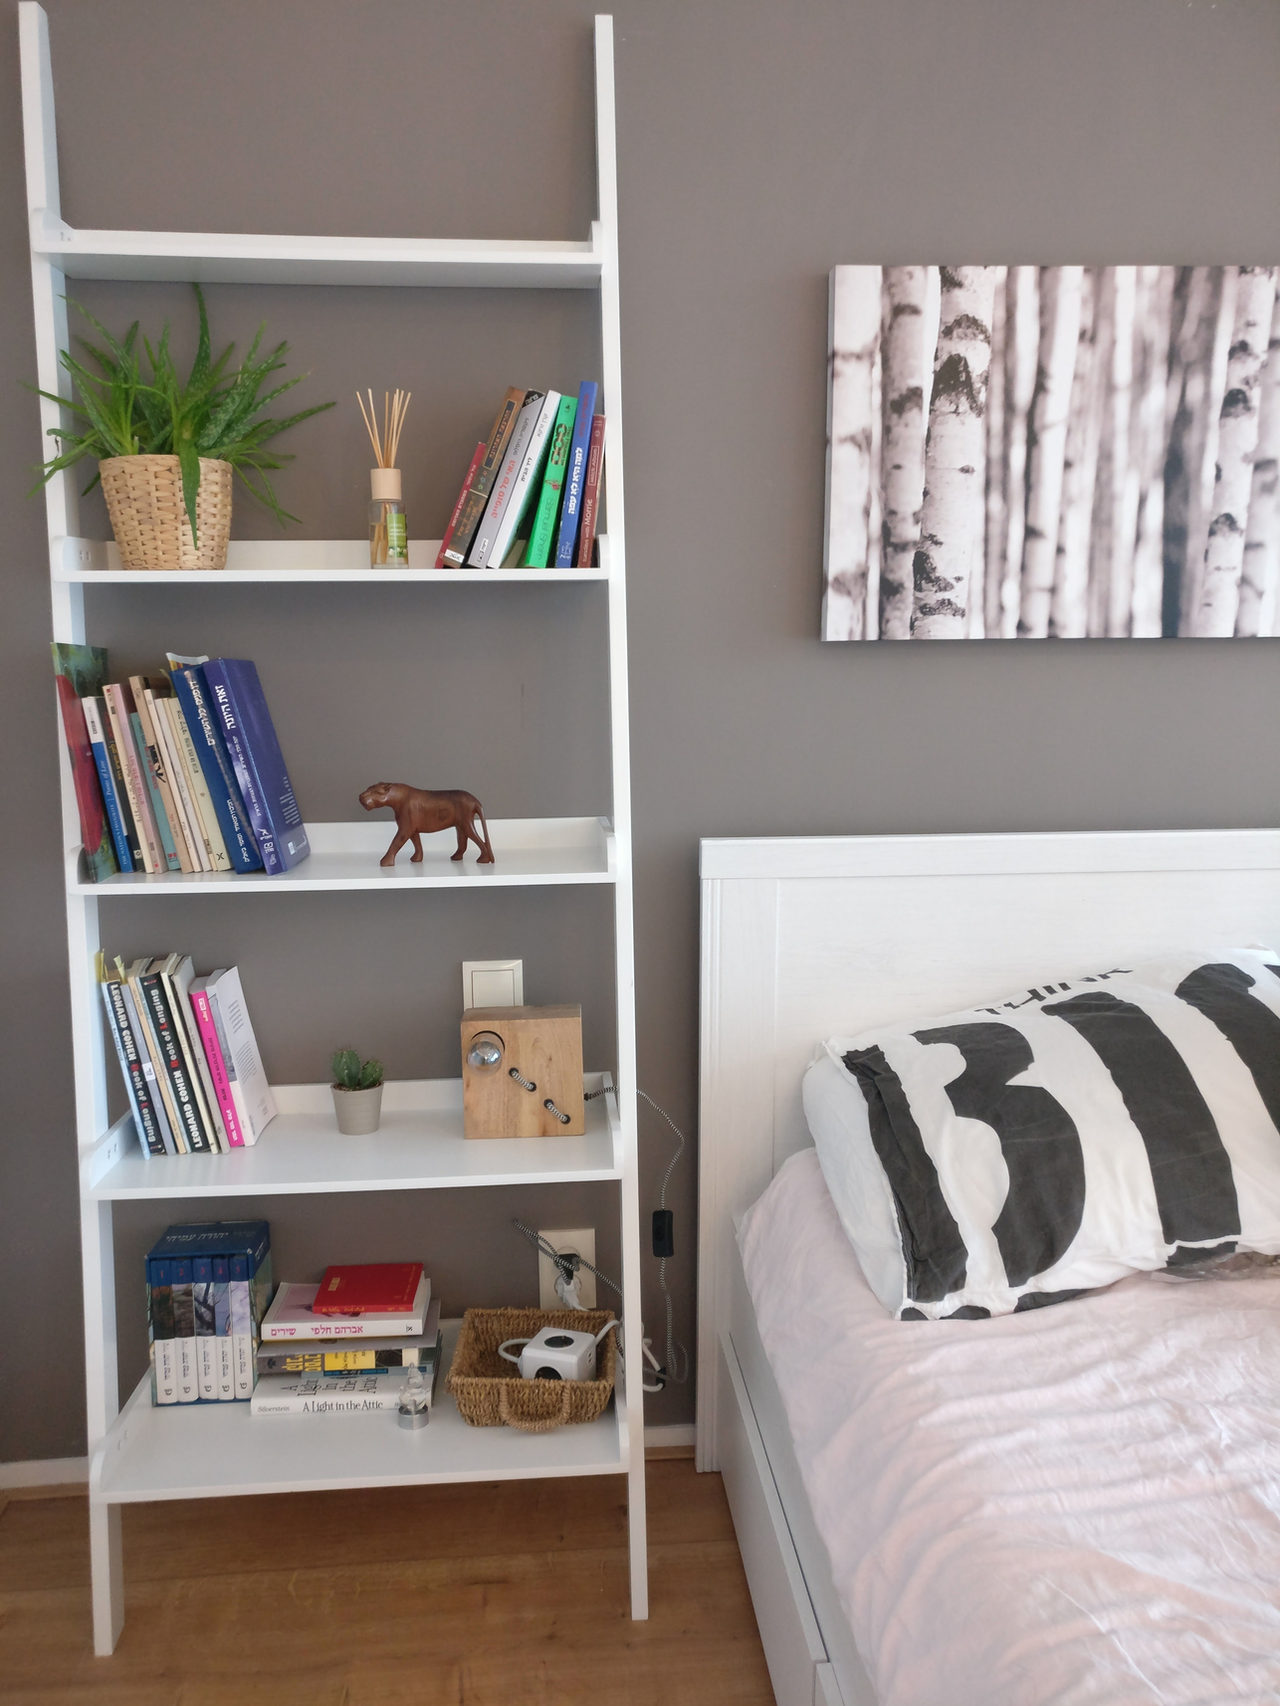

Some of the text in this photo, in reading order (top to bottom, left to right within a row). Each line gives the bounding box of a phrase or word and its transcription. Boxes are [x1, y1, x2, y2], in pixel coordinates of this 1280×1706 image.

[583, 498, 592, 525] Morrie
[213, 683, 238, 730] זאת היונה
[199, 717, 216, 746] השירים
[103, 777, 112, 795] Poems
[109, 982, 129, 1028] LEONARD
[149, 988, 169, 1030] Longing
[120, 1028, 137, 1061] COHEN
[160, 1029, 171, 1042] of
[164, 1041, 179, 1068] Book
[129, 1062, 144, 1089] Book
[172, 1069, 190, 1103] COHEN
[136, 1089, 146, 1101] of
[138, 1101, 158, 1143] Longing
[182, 1103, 203, 1148] LEONARD
[271, 1326, 296, 1336] שירים
[311, 1324, 363, 1334] אברהם חלפי
[303, 1400, 383, 1414] A Light in the Attic
